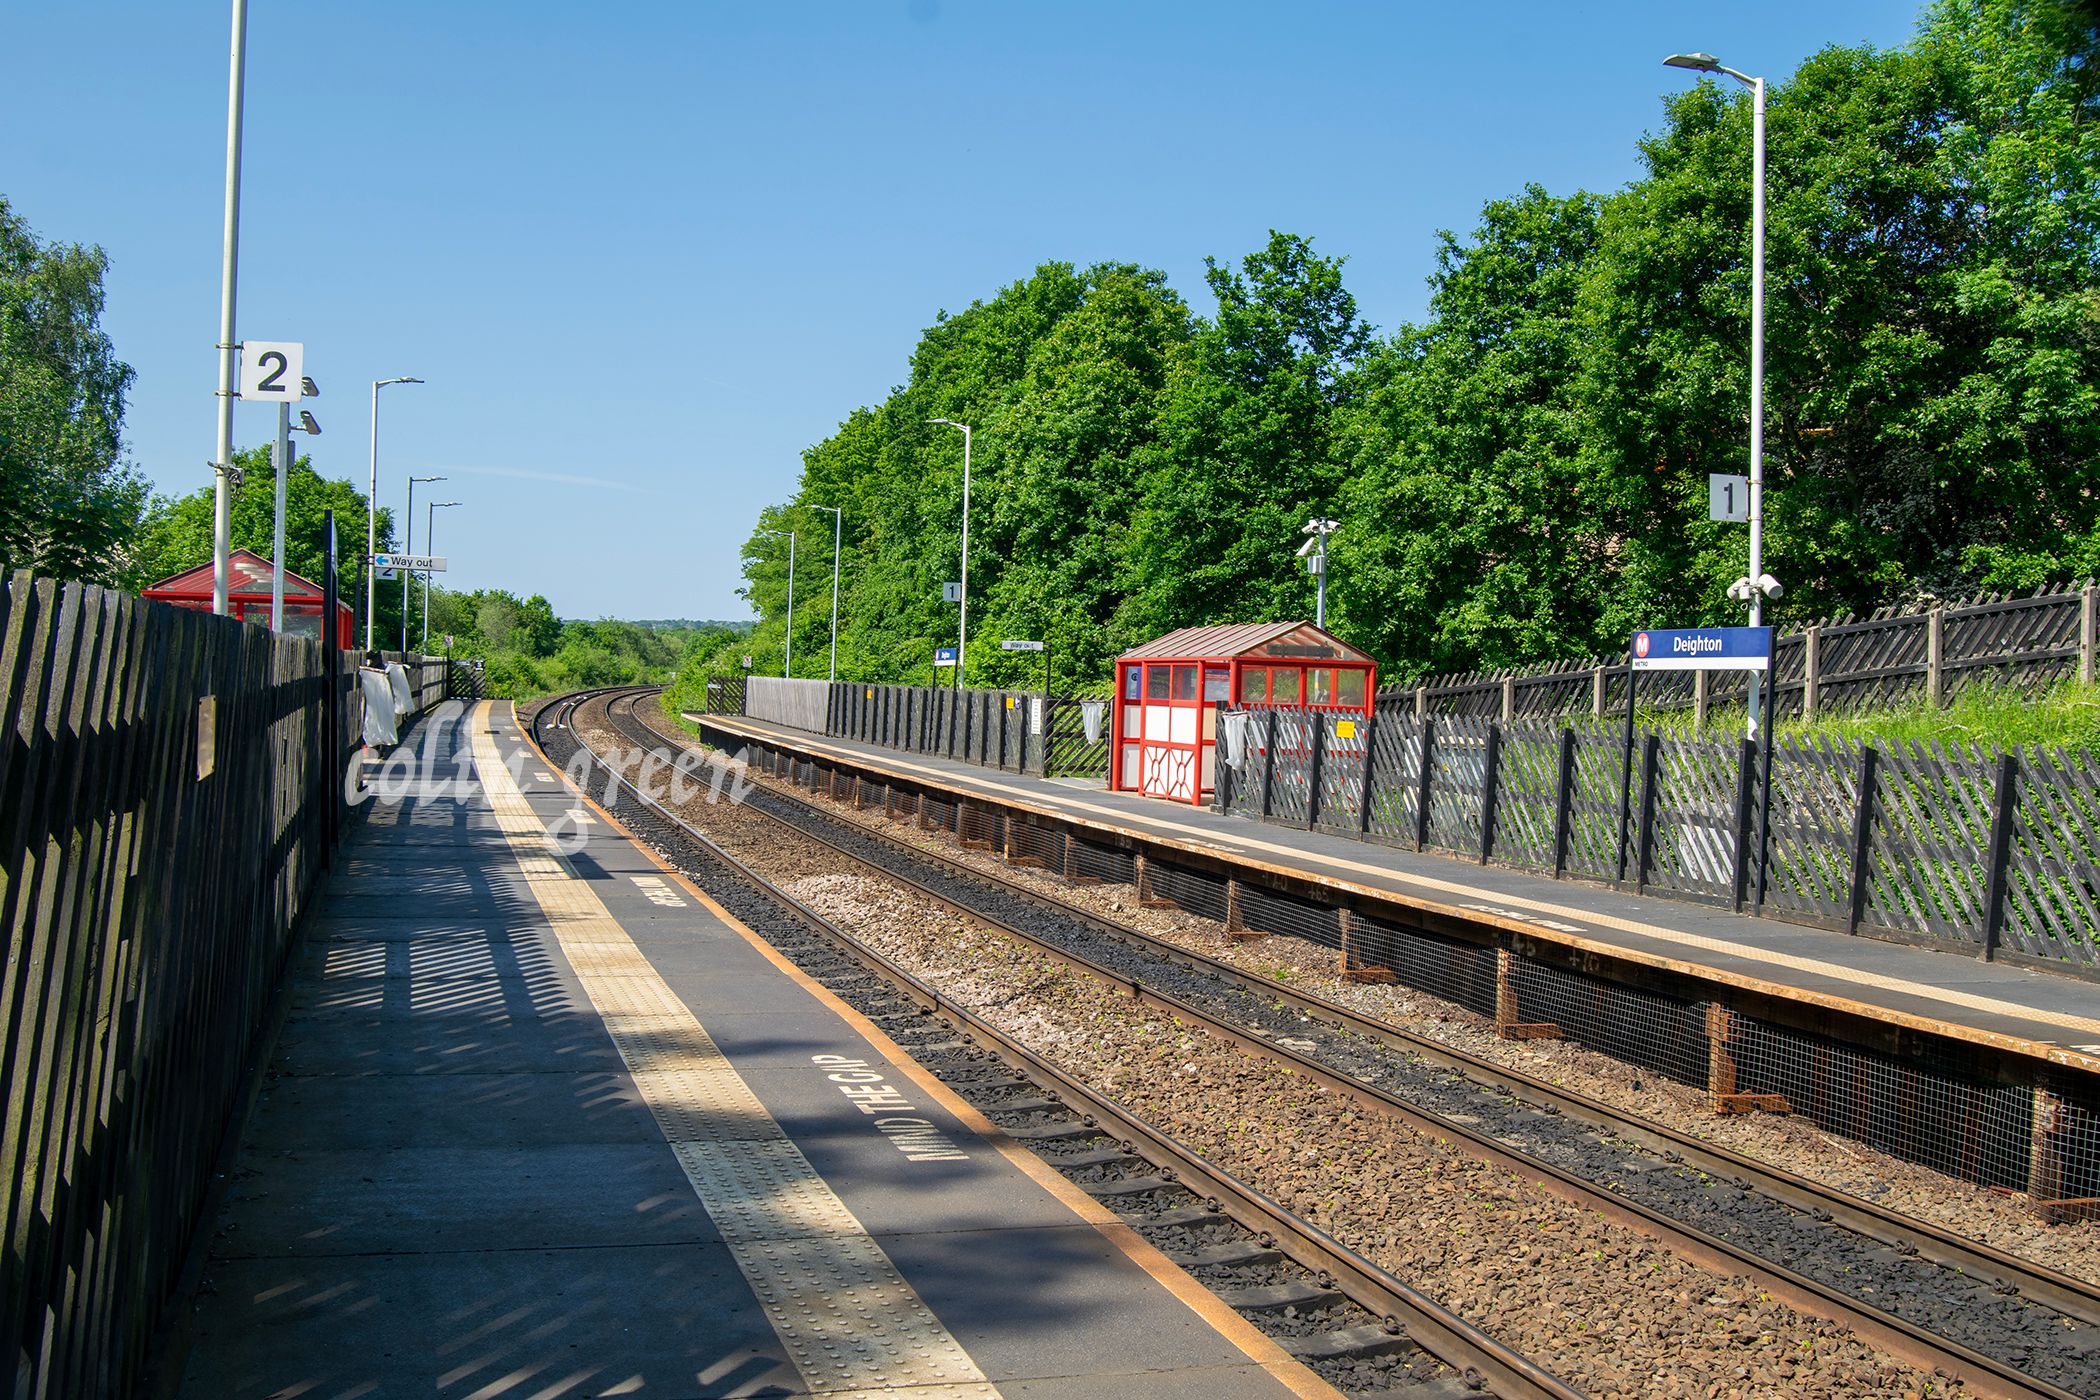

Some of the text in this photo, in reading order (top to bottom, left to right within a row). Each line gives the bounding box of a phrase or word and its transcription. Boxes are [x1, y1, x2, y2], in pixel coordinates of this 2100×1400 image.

[256, 350, 288, 393] 2
[1723, 482, 1734, 514] 1
[391, 556, 433, 568] Way out
[949, 585, 955, 599] 1
[1673, 635, 1722, 656] Deighton
[810, 1054, 970, 1162] MIND THE GAP
